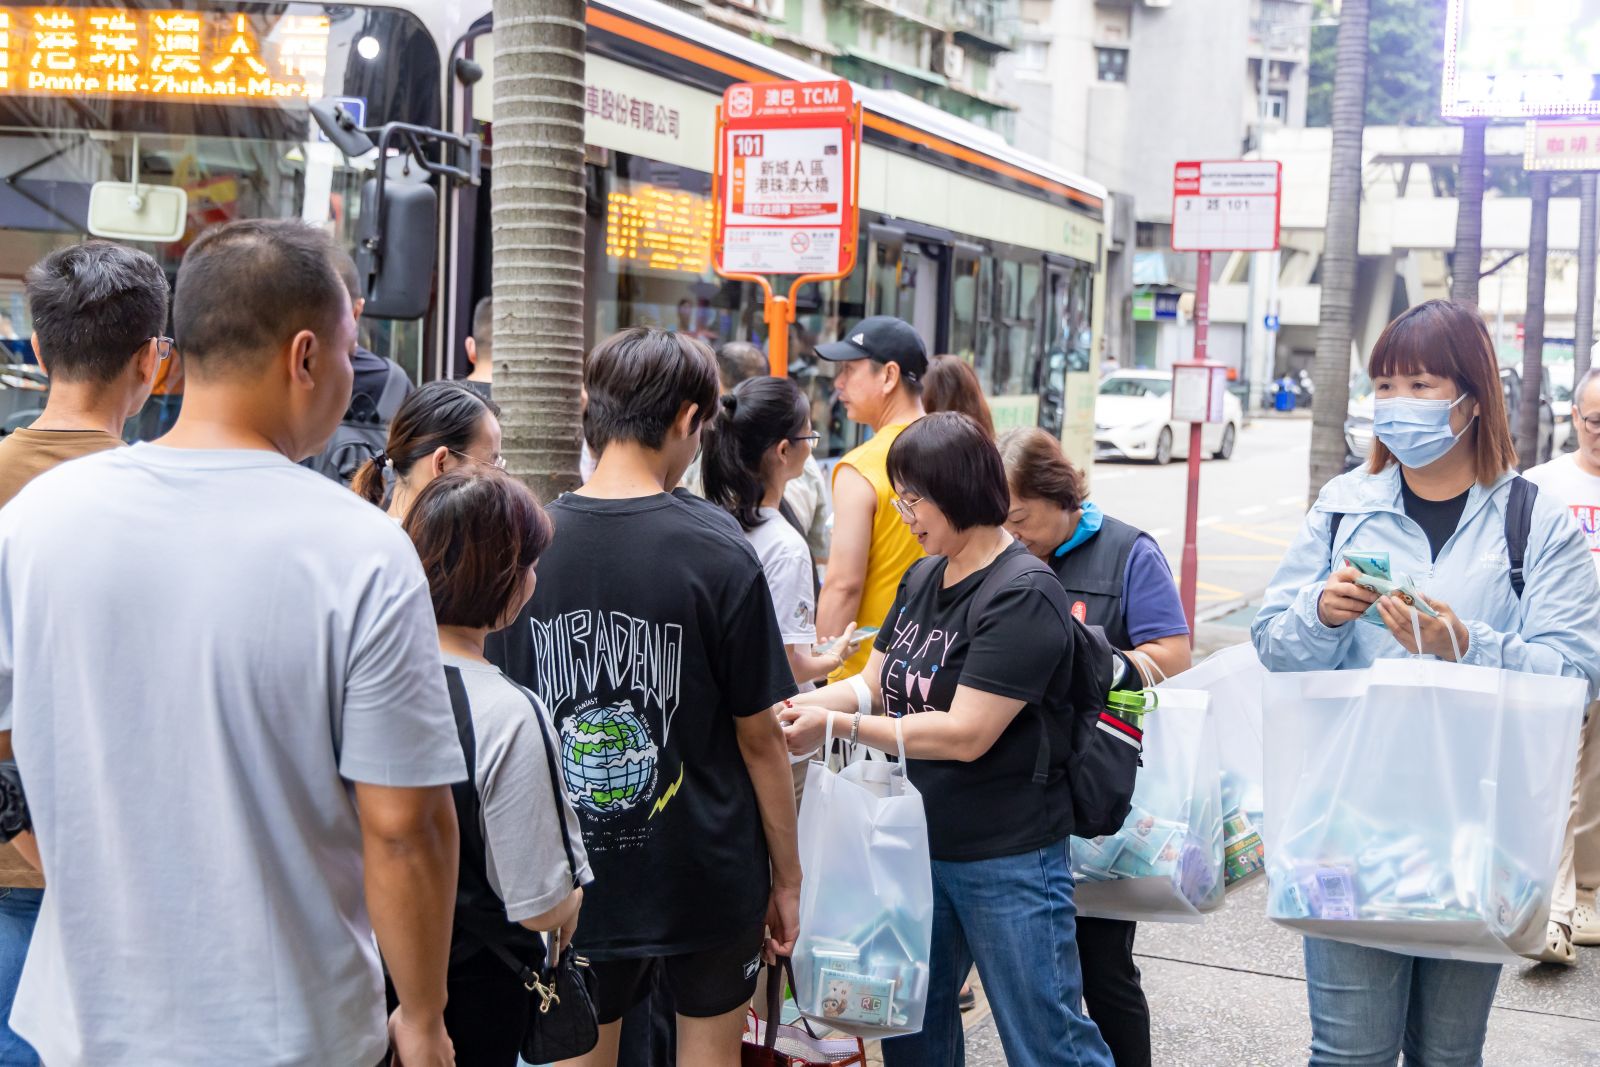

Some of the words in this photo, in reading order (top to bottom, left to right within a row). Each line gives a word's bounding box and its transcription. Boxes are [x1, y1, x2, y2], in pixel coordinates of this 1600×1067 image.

[802, 87, 840, 104] TCM
[736, 136, 761, 156] 101
[756, 177, 829, 193] 港珠澳大橋
[1228, 199, 1250, 210] 101
[575, 697, 599, 713] FANTASY
